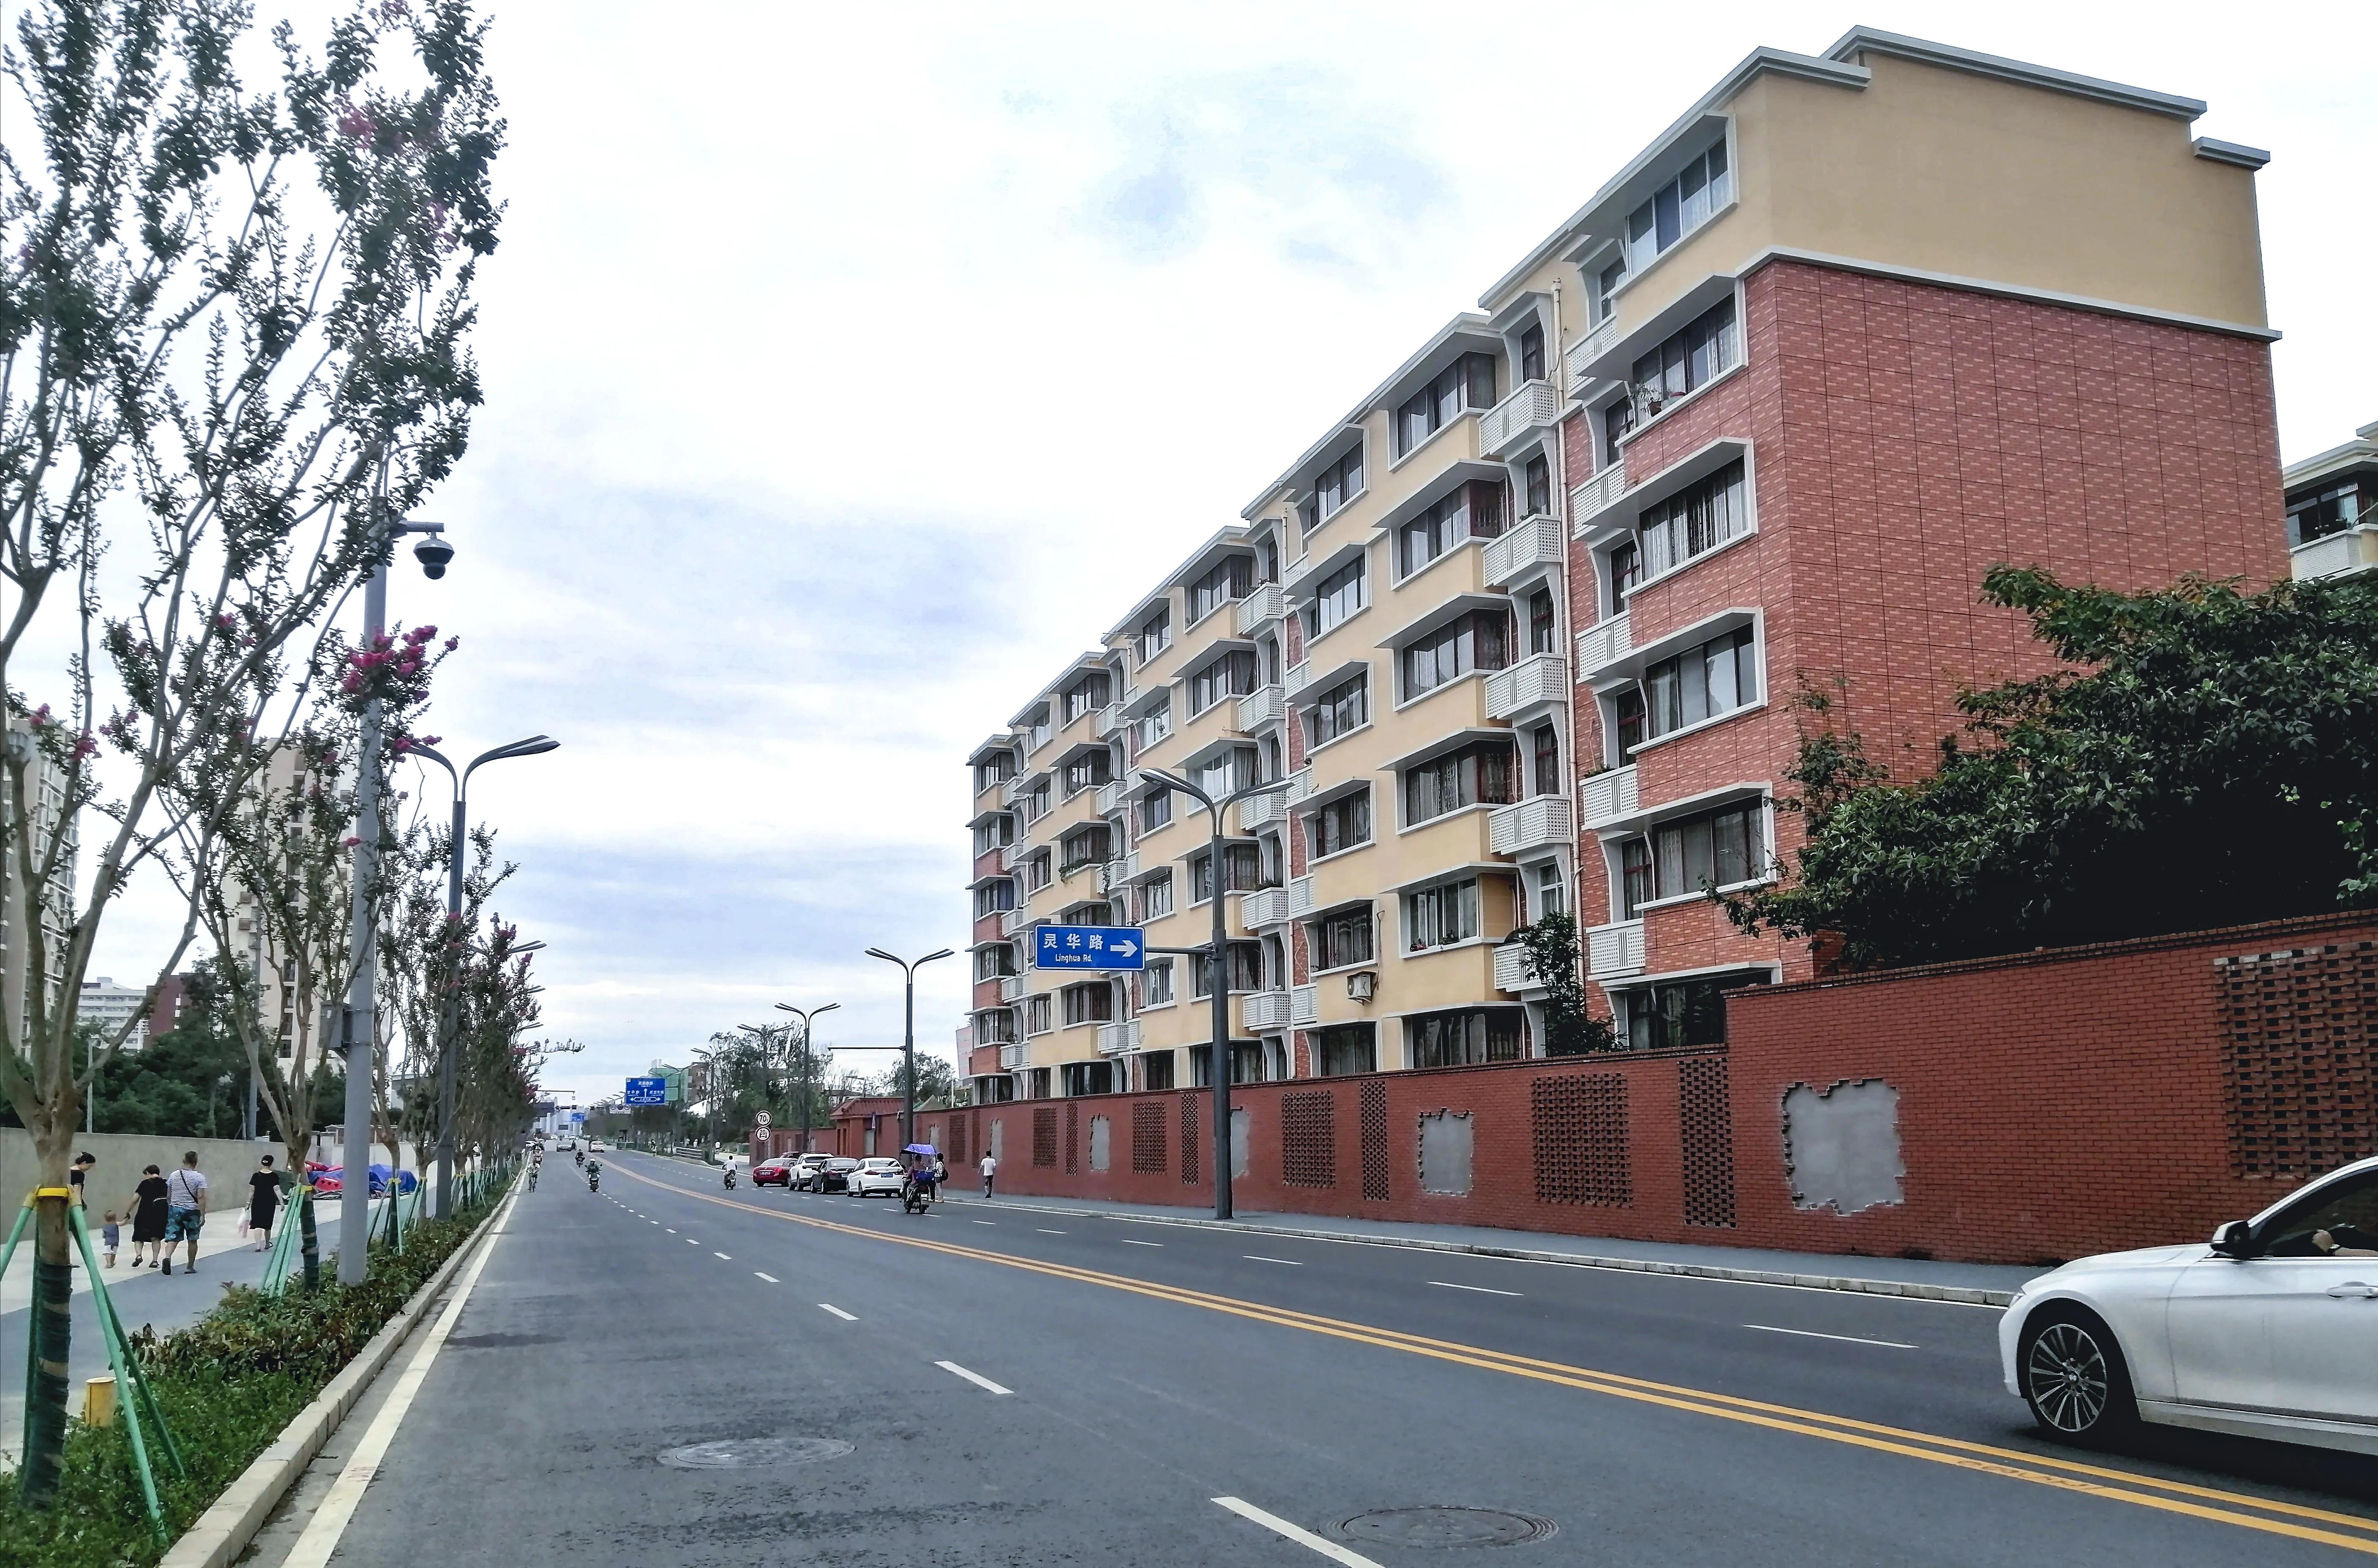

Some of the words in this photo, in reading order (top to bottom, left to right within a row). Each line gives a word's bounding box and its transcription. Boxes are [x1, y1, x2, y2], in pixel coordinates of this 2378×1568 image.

[1043, 933, 1103, 950] 灵华路
[1055, 953, 1081, 963] Linghua
